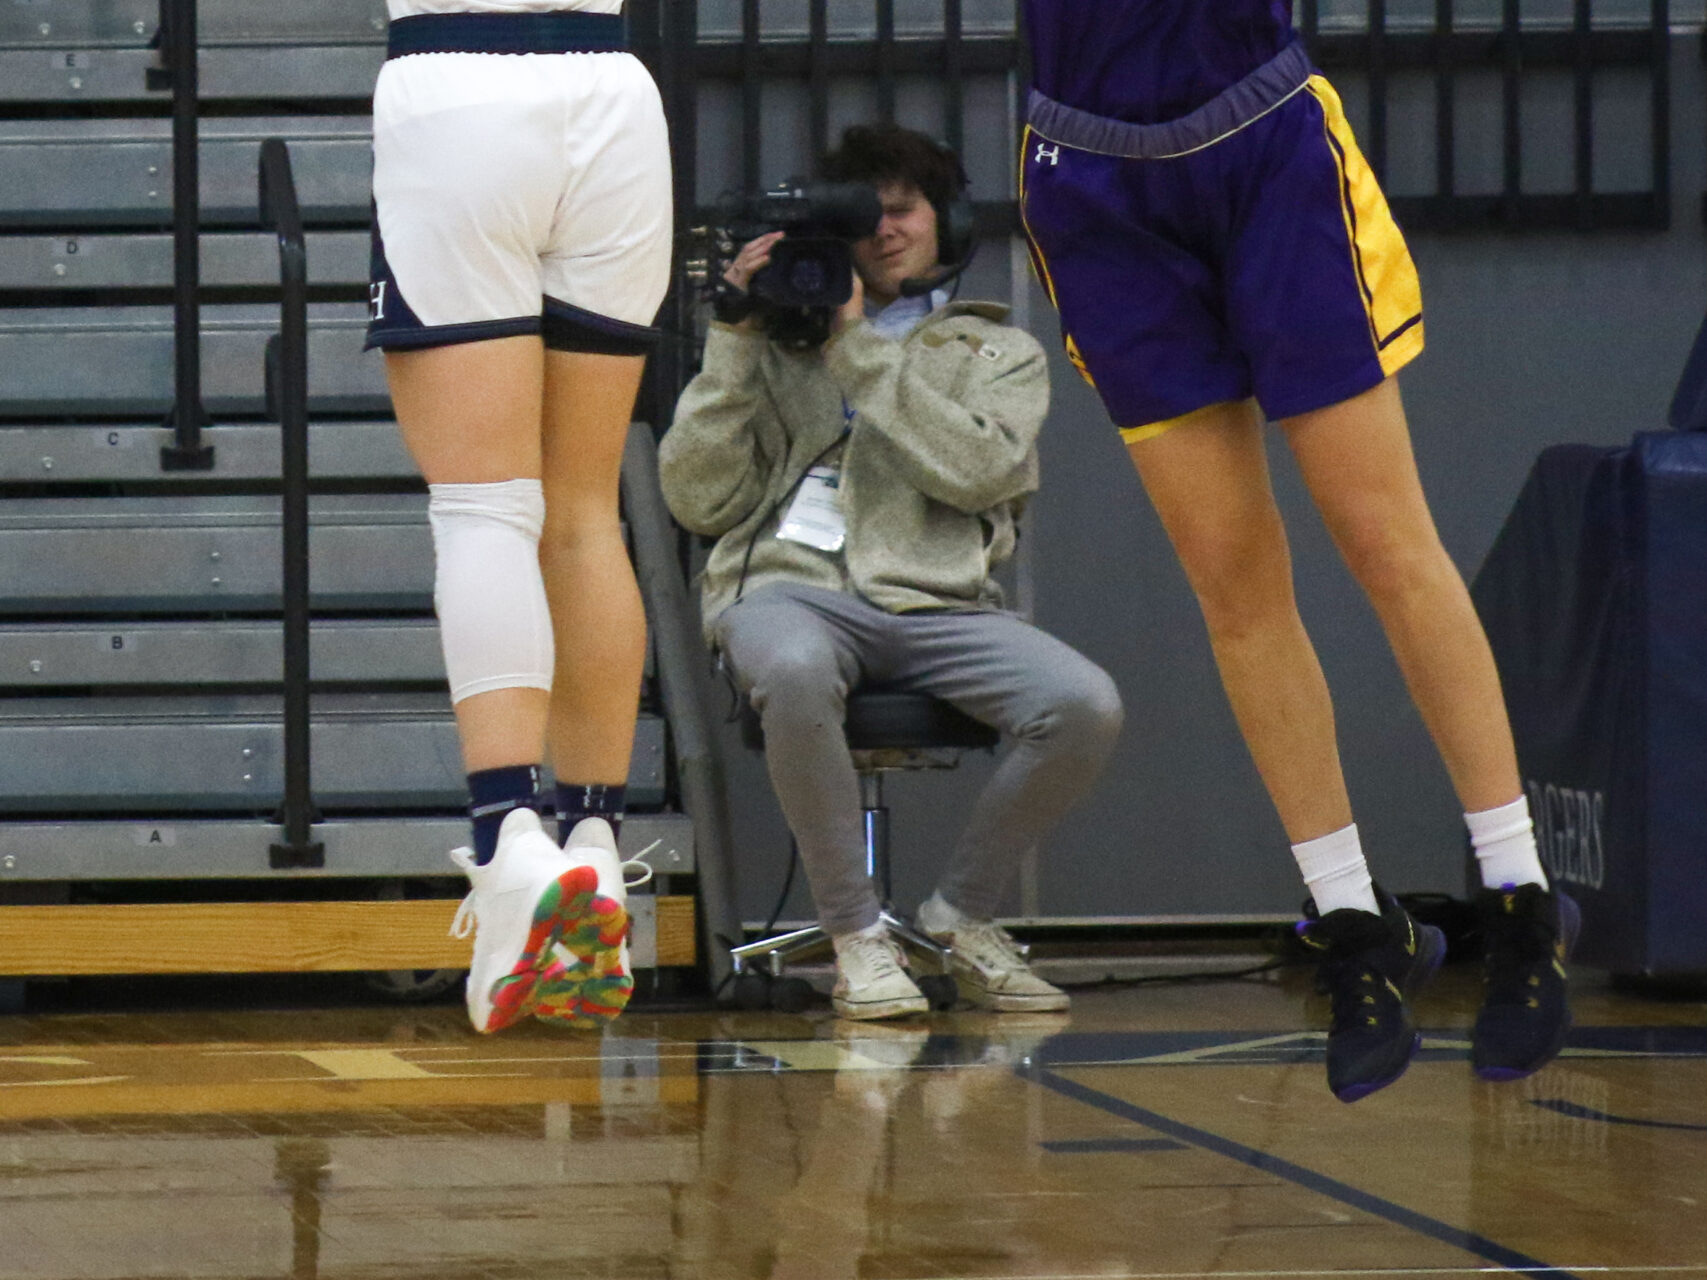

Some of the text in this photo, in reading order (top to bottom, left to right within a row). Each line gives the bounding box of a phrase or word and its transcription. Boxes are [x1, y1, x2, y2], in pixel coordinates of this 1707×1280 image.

[65, 53, 76, 67] E
[66, 241, 79, 254] D
[107, 431, 119, 445] C
[111, 635, 123, 650] B
[149, 830, 162, 844] A
